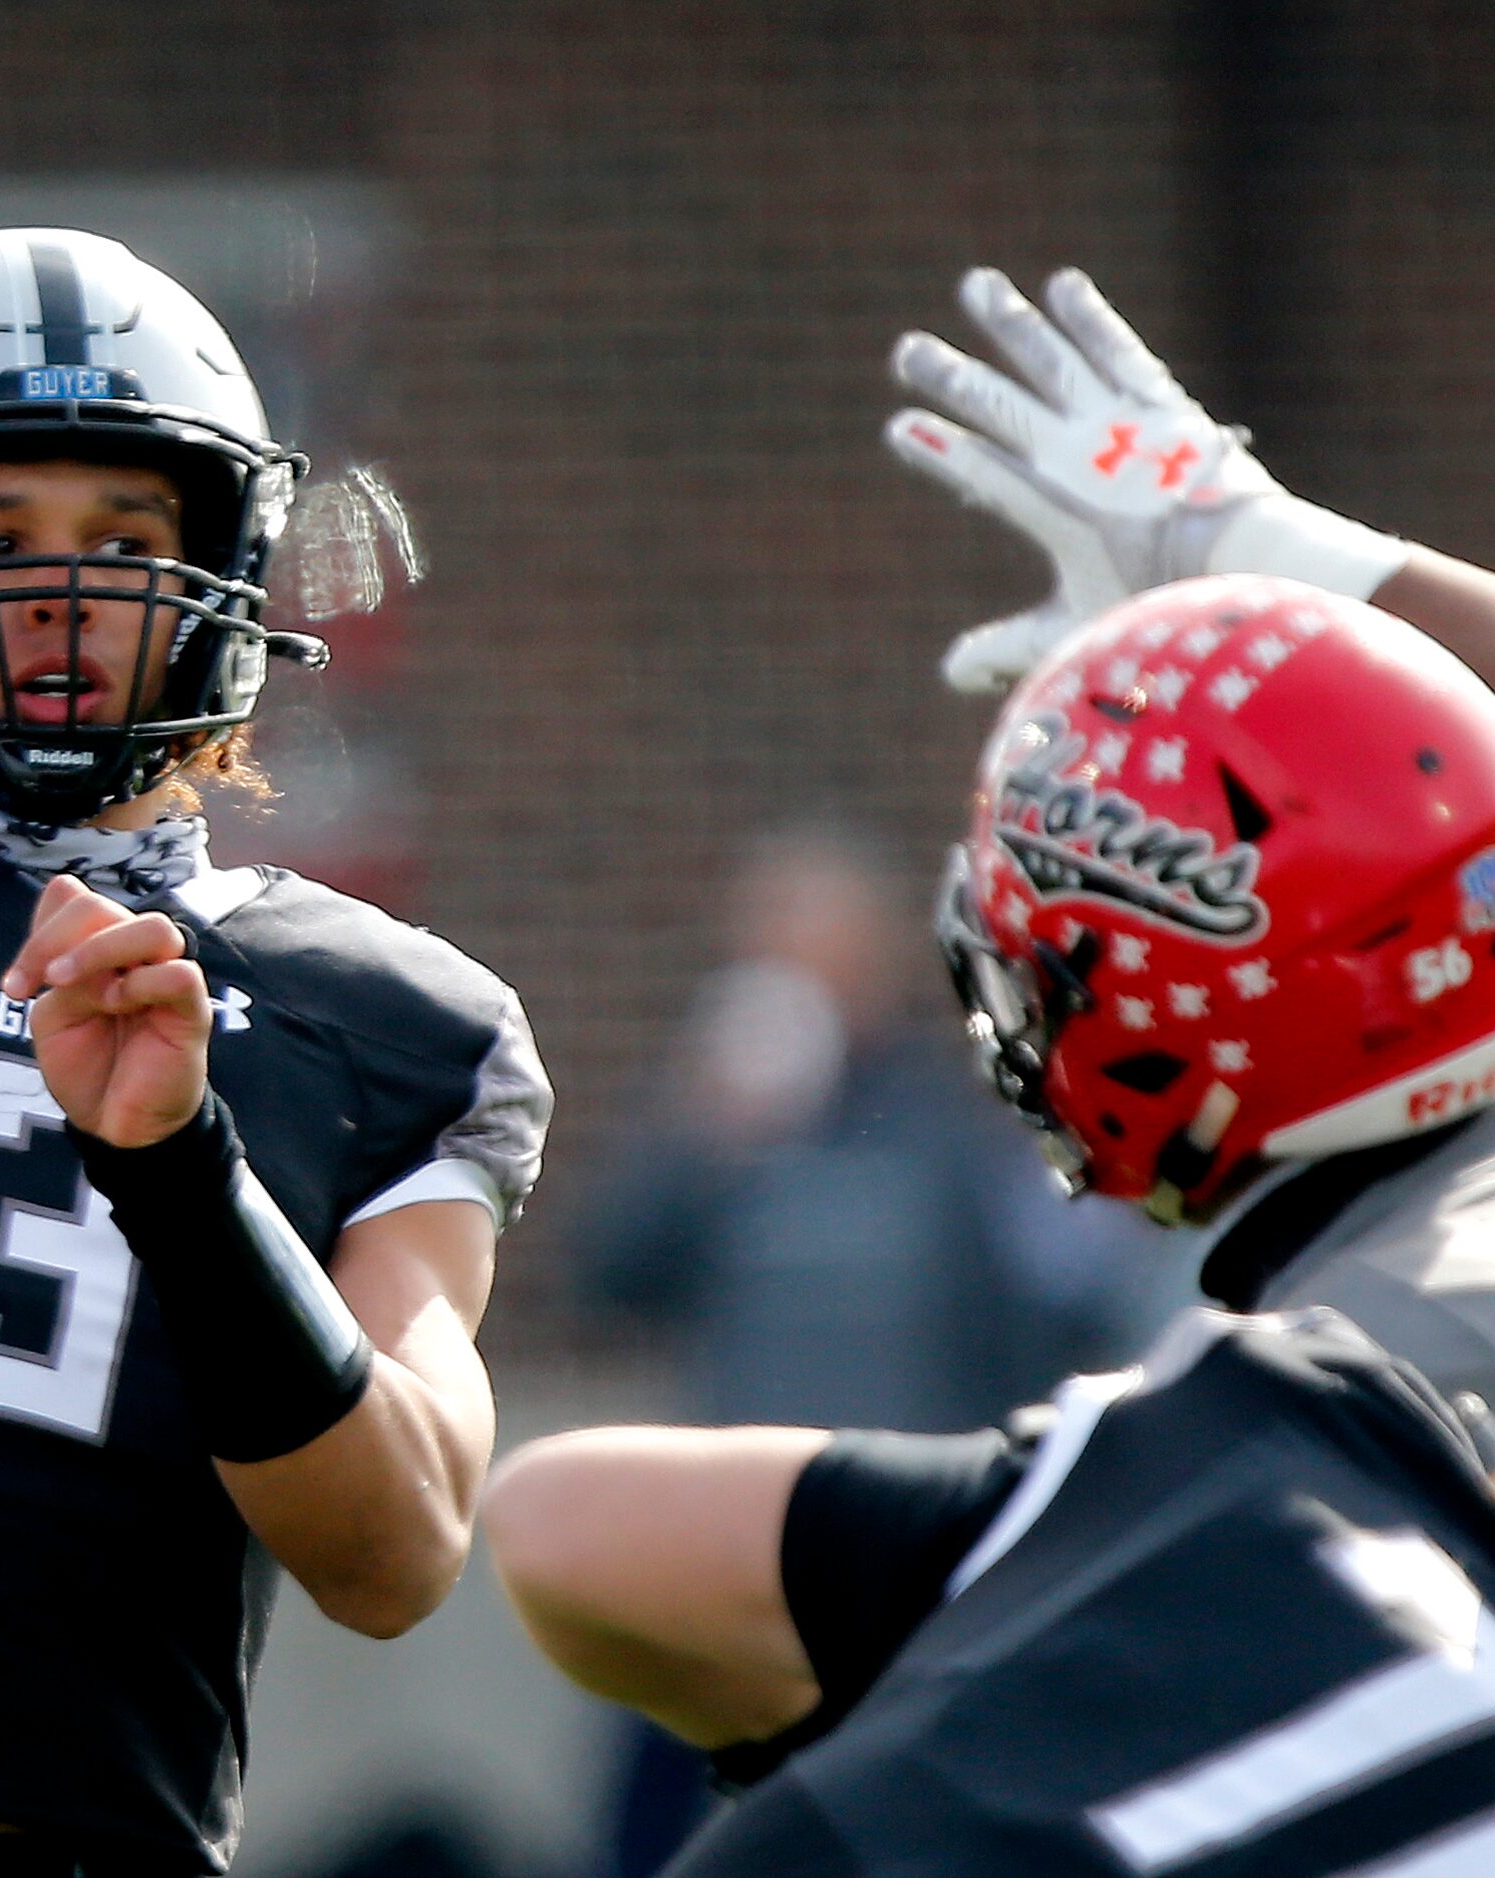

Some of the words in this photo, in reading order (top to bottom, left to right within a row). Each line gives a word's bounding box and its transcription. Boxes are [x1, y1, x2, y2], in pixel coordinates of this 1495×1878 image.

[27, 371, 109, 395] GUYER
[29, 749, 95, 766] Riddell
[1407, 937, 1474, 1003] 56
